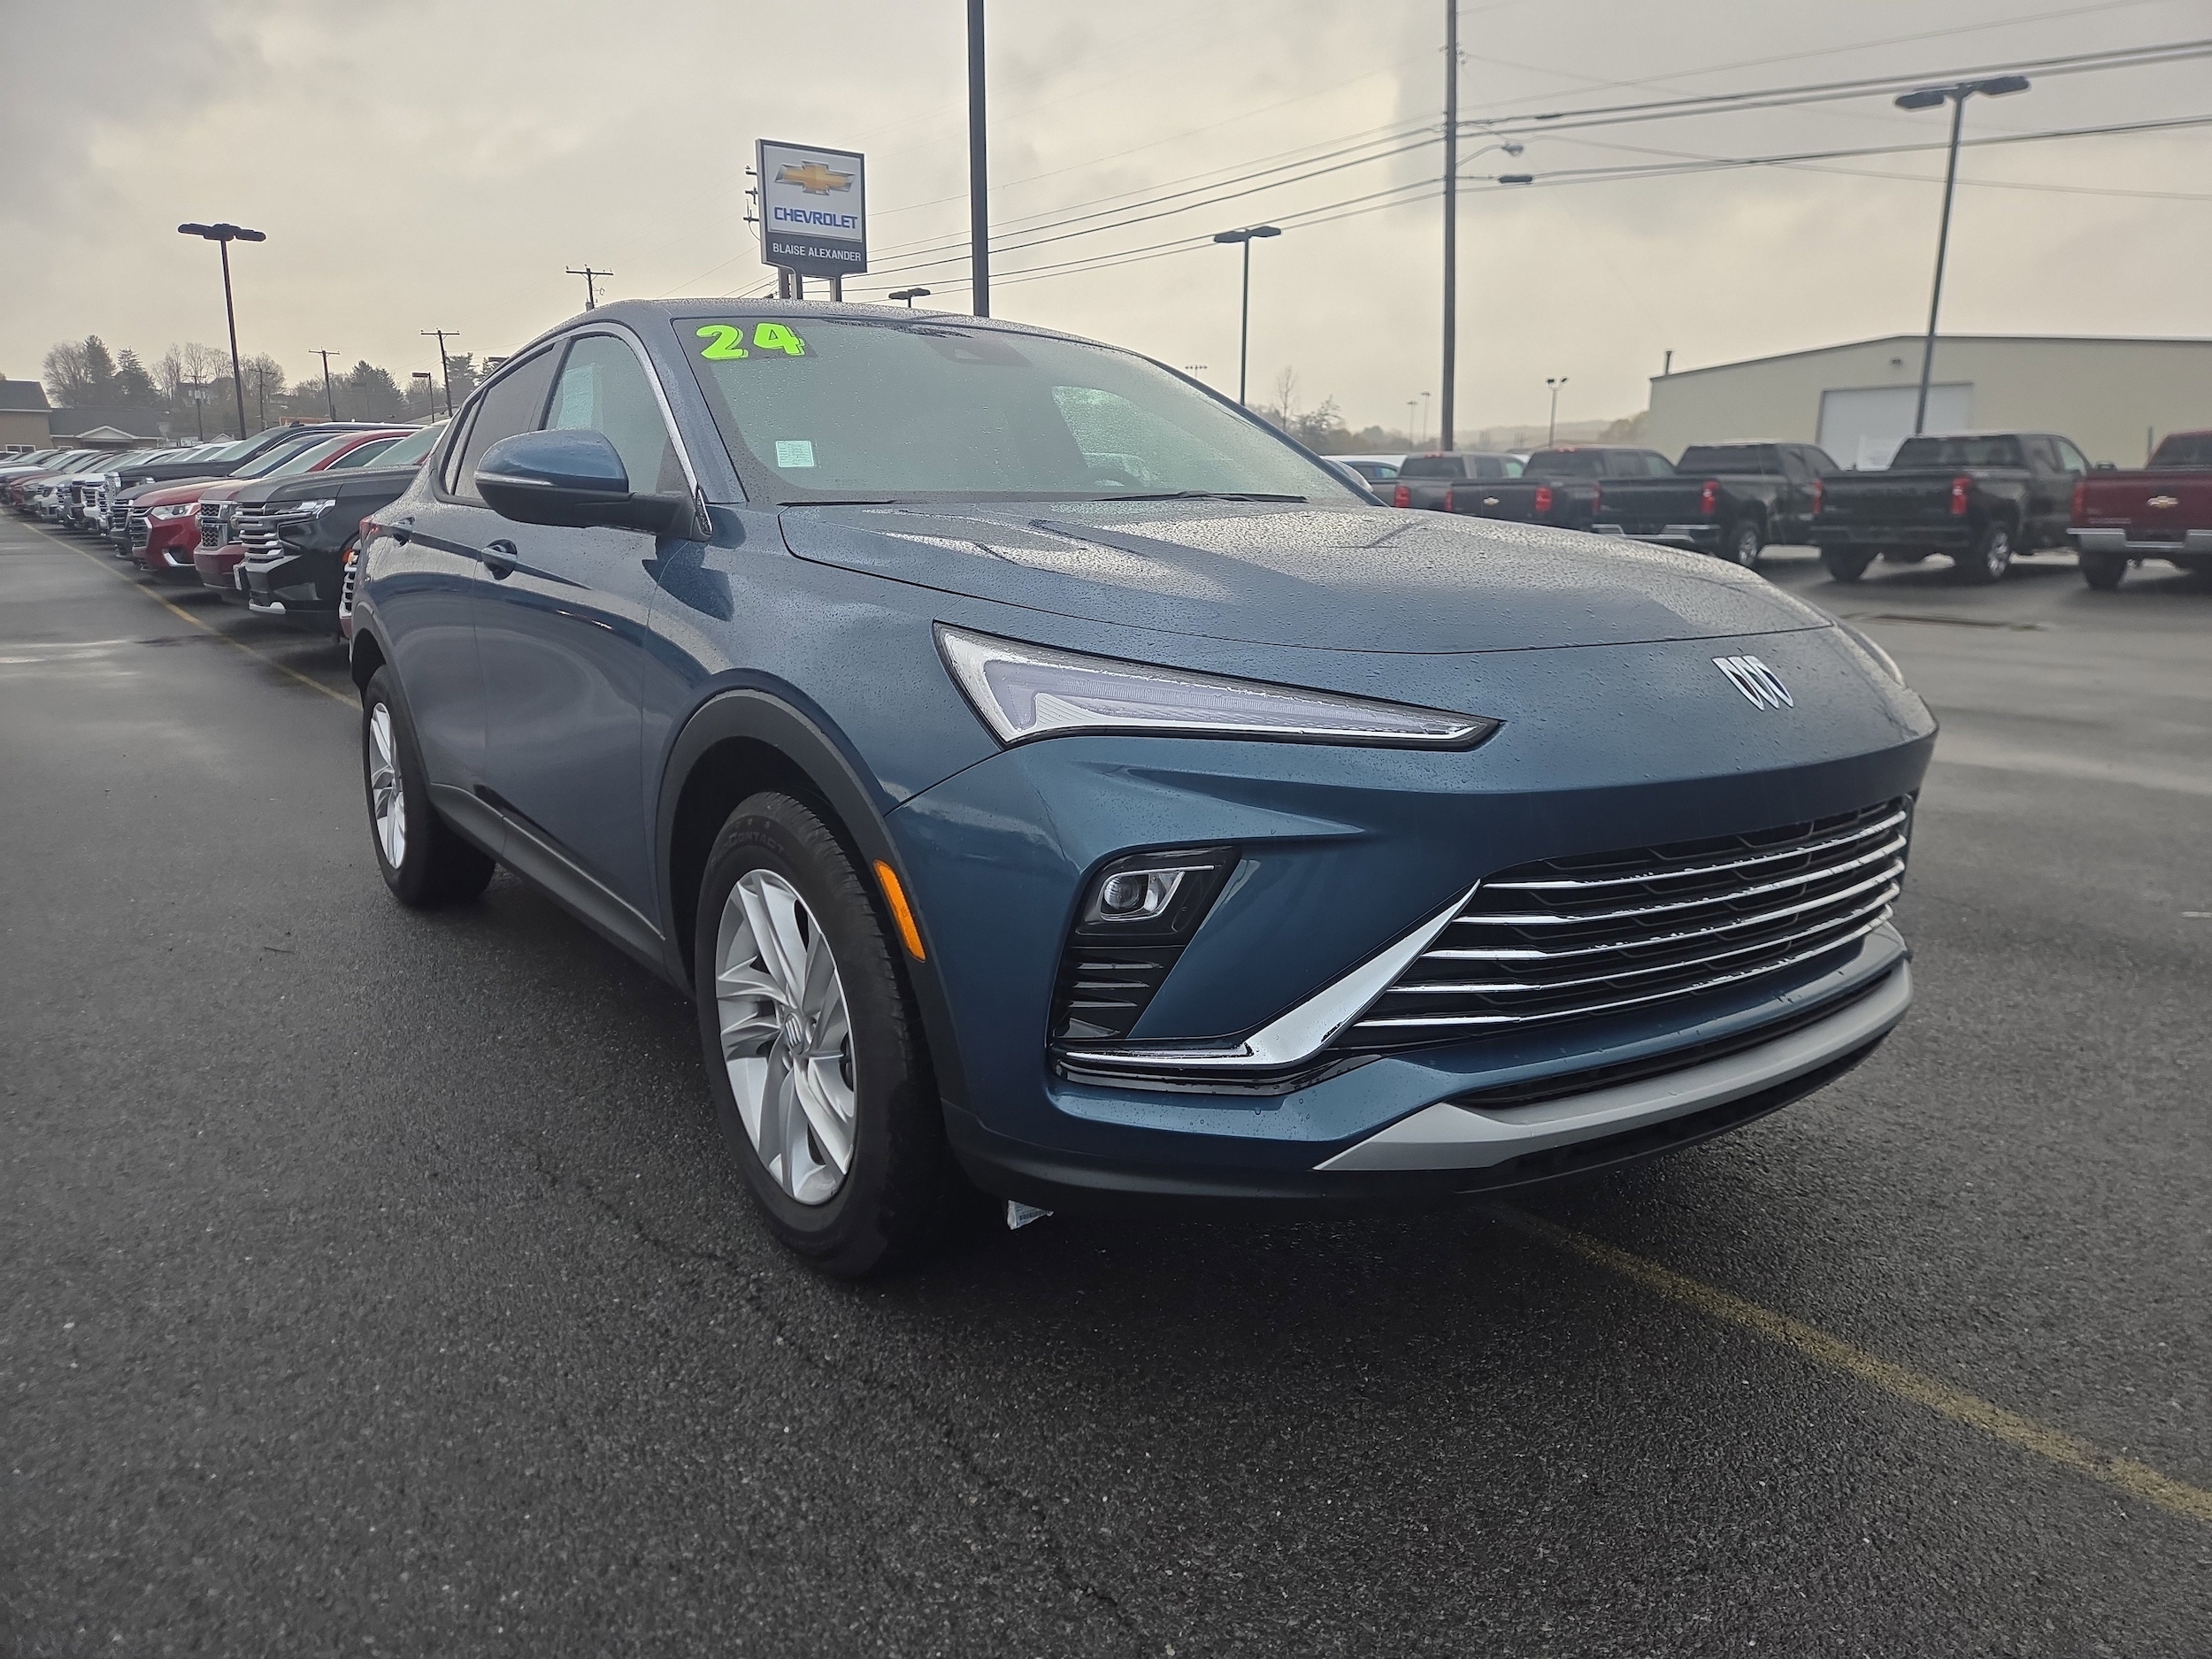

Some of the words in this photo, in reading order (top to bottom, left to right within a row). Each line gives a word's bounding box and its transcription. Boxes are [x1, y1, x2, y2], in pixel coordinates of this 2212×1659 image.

[774, 206, 858, 229] CHEVROLET
[772, 242, 806, 257] BLAISE
[808, 247, 862, 262] ALEXANDER
[695, 322, 805, 360] 24
